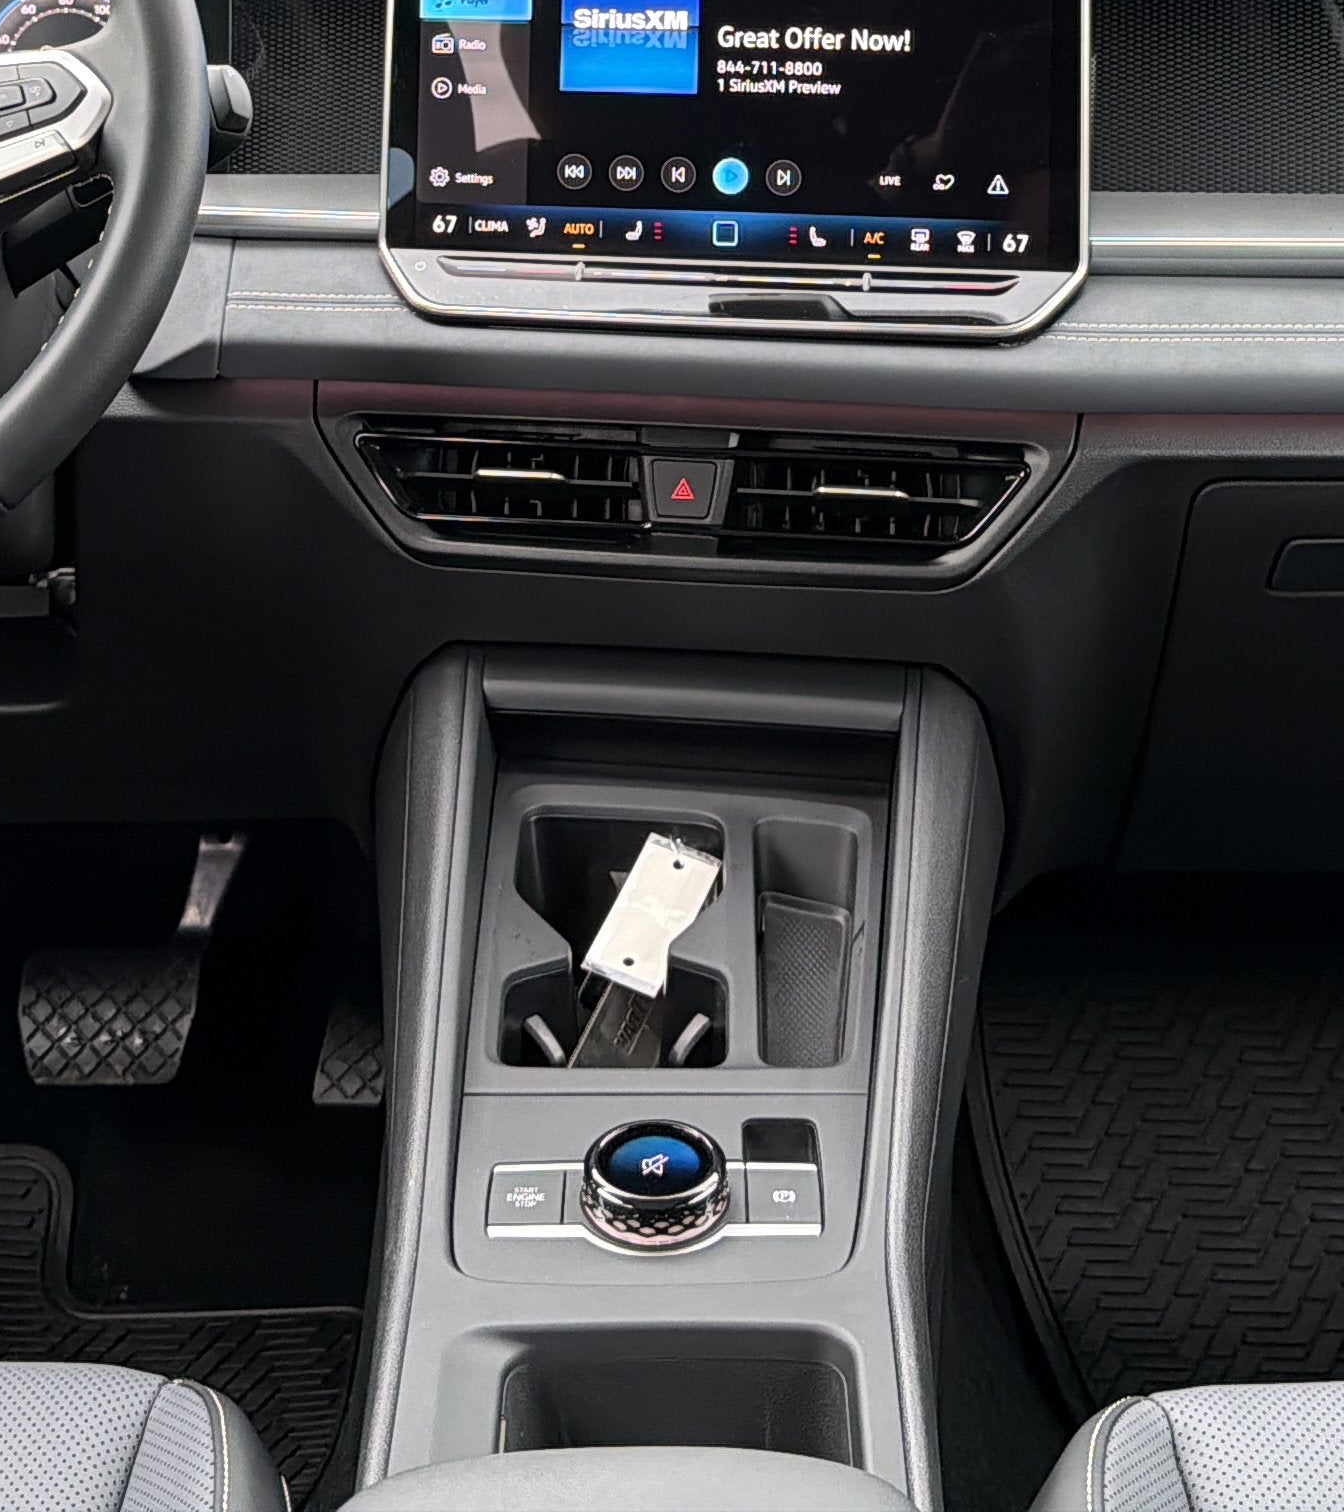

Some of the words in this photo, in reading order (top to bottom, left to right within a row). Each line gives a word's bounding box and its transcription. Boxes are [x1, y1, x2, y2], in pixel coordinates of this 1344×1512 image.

[20, 4, 37, 16] 60
[572, 8, 689, 31] SiriusXM
[458, 39, 487, 51] Radio
[717, 25, 780, 50] Great
[784, 26, 846, 50] Offer
[850, 29, 912, 52] Now!
[716, 60, 823, 77] 844-711-8800
[457, 83, 487, 96] Media
[717, 79, 725, 93] 1
[729, 79, 786, 95] SiriusXM
[788, 80, 842, 96] Preview
[454, 172, 494, 186] Settings
[879, 175, 902, 187] LIVE
[431, 214, 458, 234] 67
[474, 219, 509, 233] CLIMA
[563, 223, 595, 235] AUTO
[863, 231, 886, 246] A/C
[1002, 233, 1030, 253] 67
[506, 1192, 546, 1202] ENGINE
